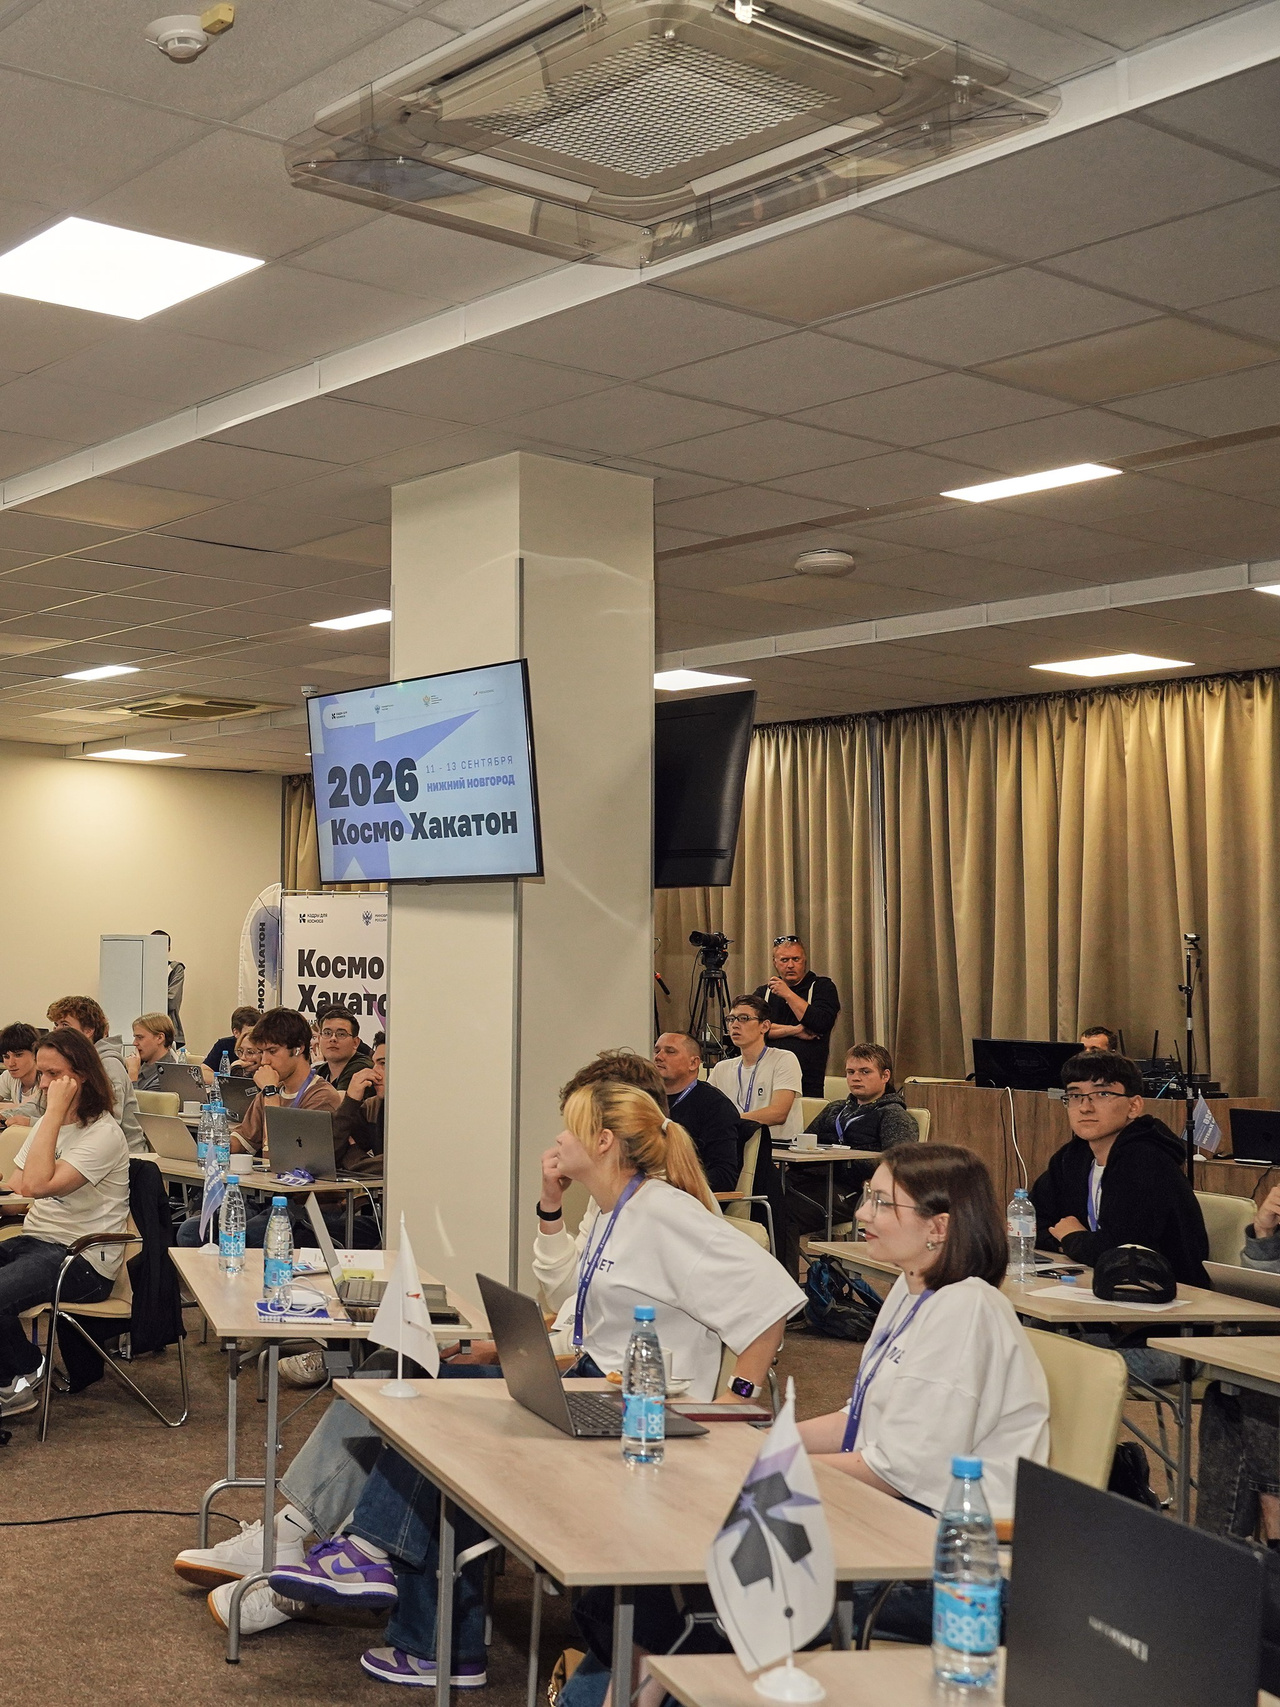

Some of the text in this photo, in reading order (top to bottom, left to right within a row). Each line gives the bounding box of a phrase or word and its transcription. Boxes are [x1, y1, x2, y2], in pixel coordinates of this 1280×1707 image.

[425, 765, 435, 774] 11
[446, 762, 457, 771] 13
[461, 755, 513, 770] СЕНТЯБРЯ
[327, 757, 419, 808] 2026
[426, 774, 516, 792] НИЖНИЙ НОВГОРОД
[330, 811, 518, 846] Космо Хакатон
[258, 922, 266, 1013] МОХАКАТОН
[297, 949, 384, 980] Космо
[297, 984, 386, 1017] Хакато
